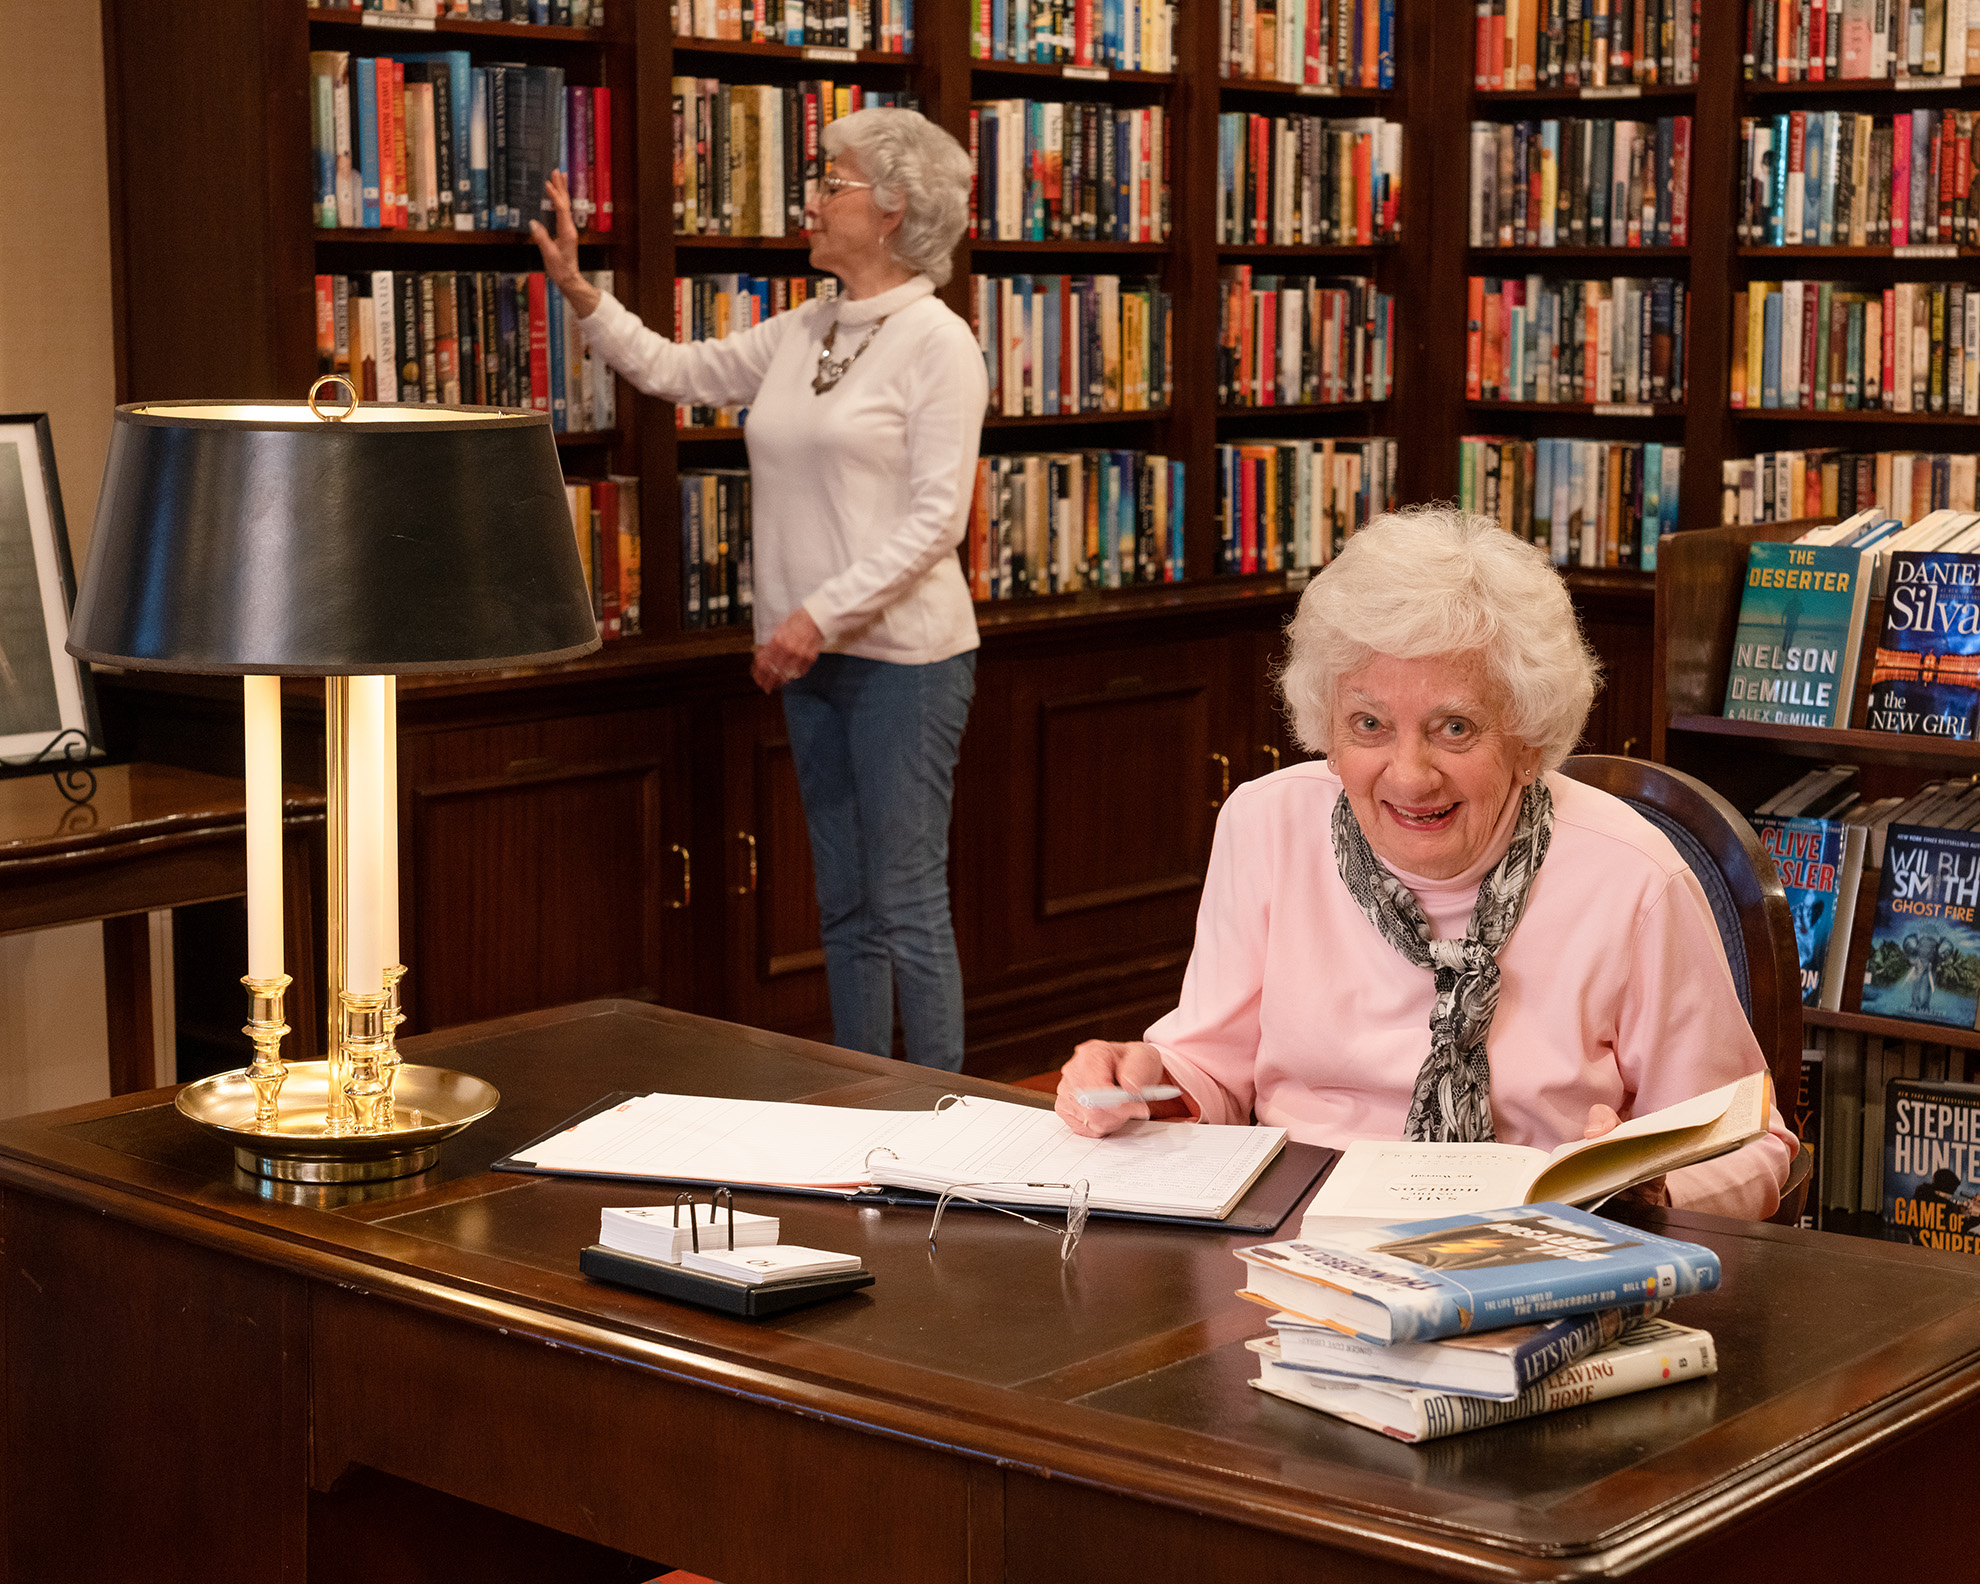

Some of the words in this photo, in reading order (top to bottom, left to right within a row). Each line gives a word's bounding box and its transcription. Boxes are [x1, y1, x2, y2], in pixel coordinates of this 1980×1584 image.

[383, 112, 394, 159] BALDACCI
[378, 276, 389, 316] STEVE
[380, 320, 391, 364] BERRY
[1788, 550, 1816, 566] THE
[1748, 568, 1850, 592] DESERTER
[1895, 560, 1980, 587] DANIE
[1888, 584, 1980, 635] Silva
[1736, 644, 1838, 674] NELSON
[1884, 691, 1906, 709] the
[1737, 708, 1771, 723] ALEX
[1871, 711, 1920, 731] NEW
[1922, 714, 1973, 737] GIRL
[1761, 826, 1822, 860] CLIVE
[1923, 836, 1938, 844] TIMES
[1938, 838, 1970, 847] BESTSELLING
[1771, 857, 1835, 892] SLER
[1892, 869, 1979, 908] SMITH
[1892, 898, 1942, 917] GHOST
[1944, 905, 1975, 923] FIRE
[1926, 1094, 1942, 1102] TIMES
[1896, 1098, 1980, 1143] STEPHE
[1895, 1197, 1947, 1231] GAME
[1949, 1213, 1965, 1233] OF
[1623, 1281, 1640, 1293] BILL
[1484, 1300, 1497, 1311] THE
[1497, 1298, 1511, 1309] LIFE
[1511, 1296, 1525, 1306] AND
[1514, 1303, 1532, 1316] THE
[1534, 1293, 1598, 1312] THUNDERBOLT
[1600, 1290, 1617, 1301] KID
[1523, 1341, 1560, 1382] LET'S
[1548, 1358, 1615, 1389] LEAVING
[1550, 1385, 1595, 1410] HOME
[1424, 1396, 1455, 1439] ART
